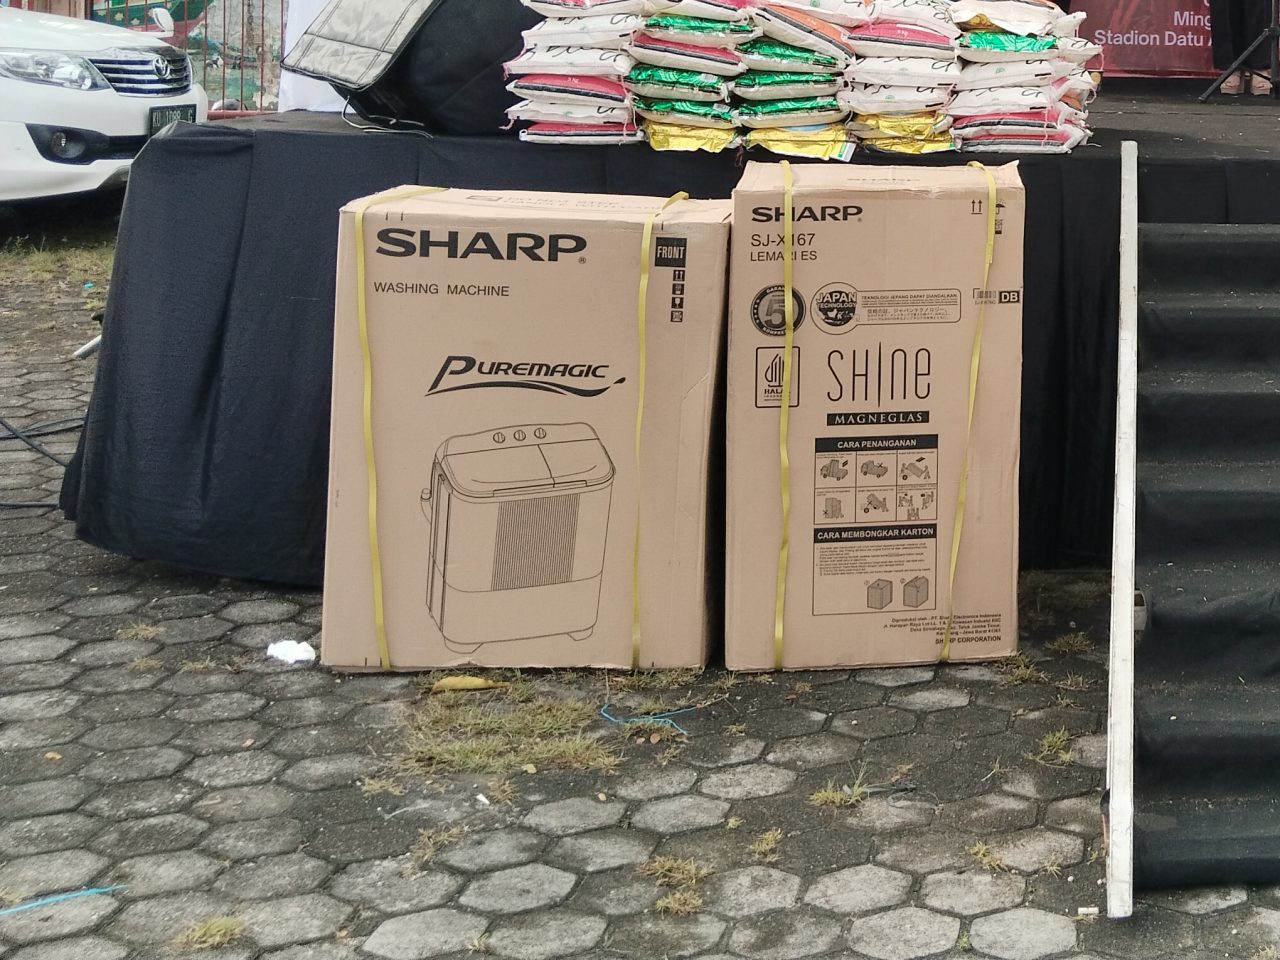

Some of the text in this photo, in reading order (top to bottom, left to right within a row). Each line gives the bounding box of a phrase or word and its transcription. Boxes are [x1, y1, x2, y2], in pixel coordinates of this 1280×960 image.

[1174, 11, 1211, 30] Ming
[1094, 29, 1160, 46] Stadion
[1164, 31, 1203, 47] Datu
[752, 205, 863, 223] SHARP
[375, 227, 588, 263] SHARP
[751, 233, 816, 247] SJ-X167
[656, 246, 685, 259] FRONT
[750, 250, 818, 262] LEMAI ES
[373, 281, 510, 297] WASHING MACHINE
[816, 292, 857, 303] JAPAN
[1000, 292, 1019, 302] DB
[427, 355, 610, 394] PUREMAGIC
[834, 413, 923, 425] MAGNEGLAS
[837, 439, 917, 449] CARA PENANGANAN
[817, 527, 934, 540] CARA MEMBONGKAR KARTON
[957, 635, 1001, 644] CORPORATION
